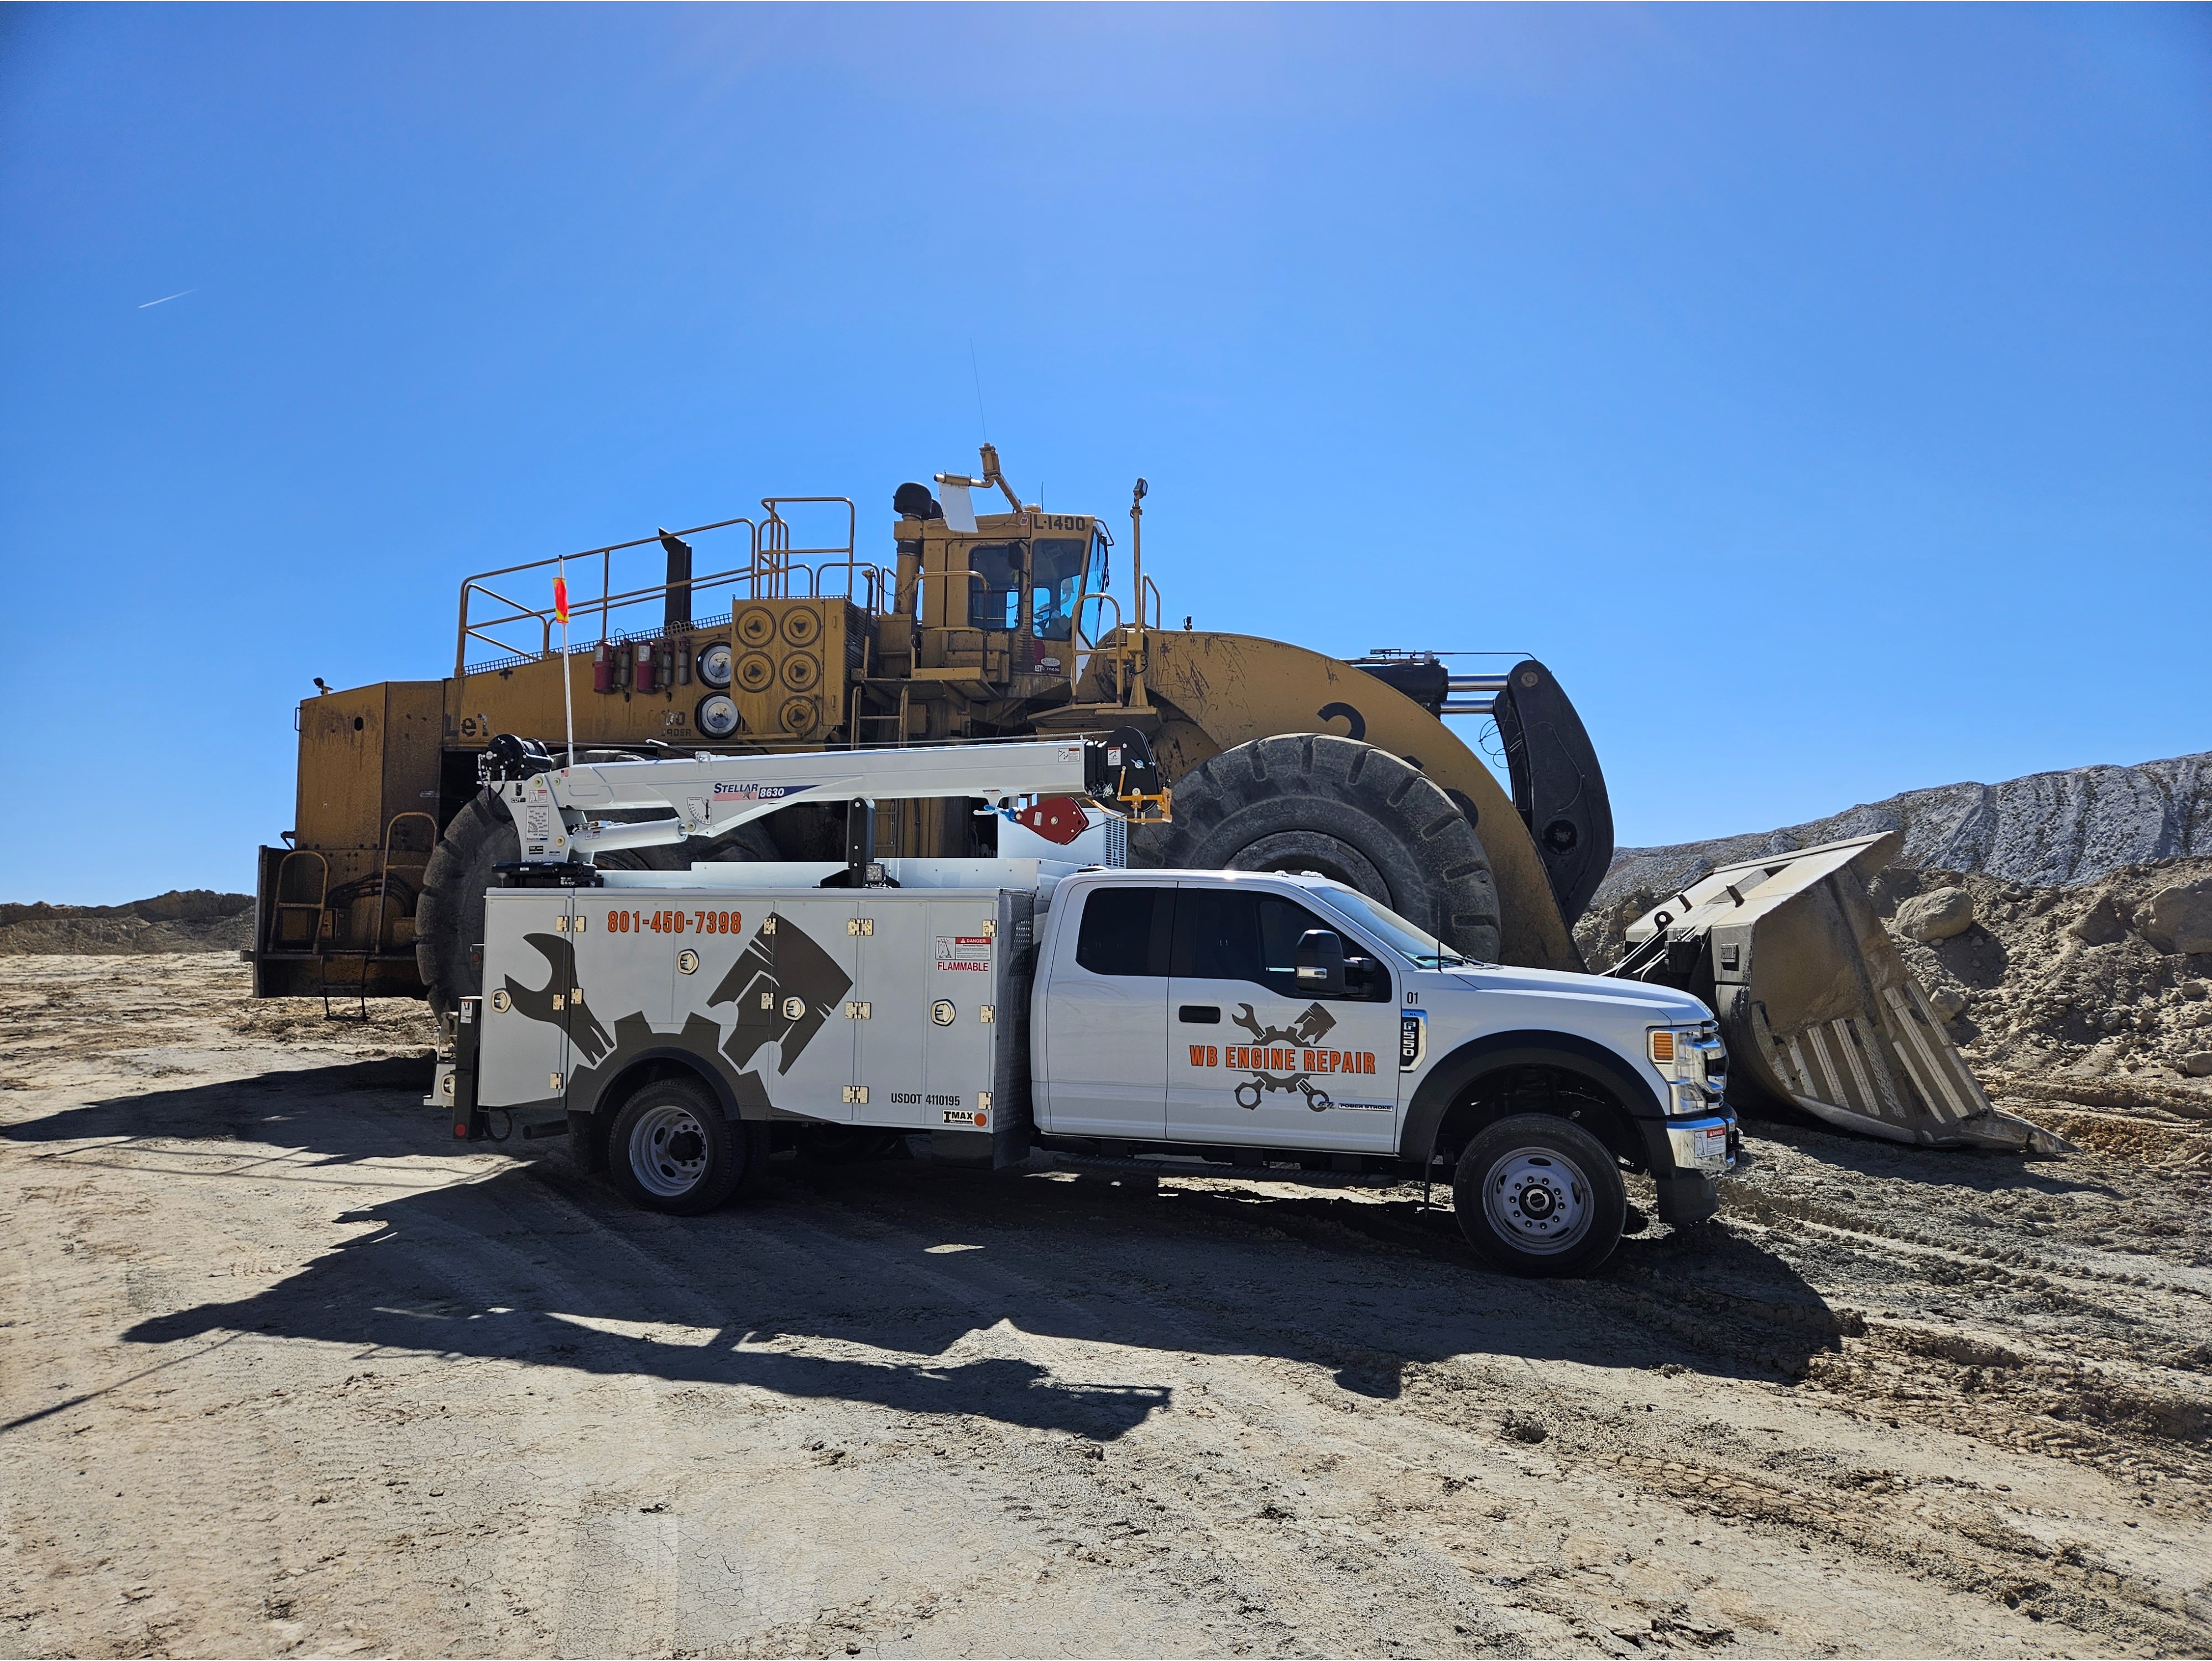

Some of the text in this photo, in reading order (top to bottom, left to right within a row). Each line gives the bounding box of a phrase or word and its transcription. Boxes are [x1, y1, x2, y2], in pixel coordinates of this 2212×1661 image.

[1034, 514, 1086, 531] L-1400
[714, 783, 785, 797] STELLAR 8630
[607, 910, 742, 934] 801-450-7398
[937, 962, 989, 971] FLAMMABLE
[1407, 991, 1418, 1004] 01
[1189, 1045, 1376, 1074] WB ENGINE REPAIR
[891, 1093, 960, 1106] USDOT 4110195
